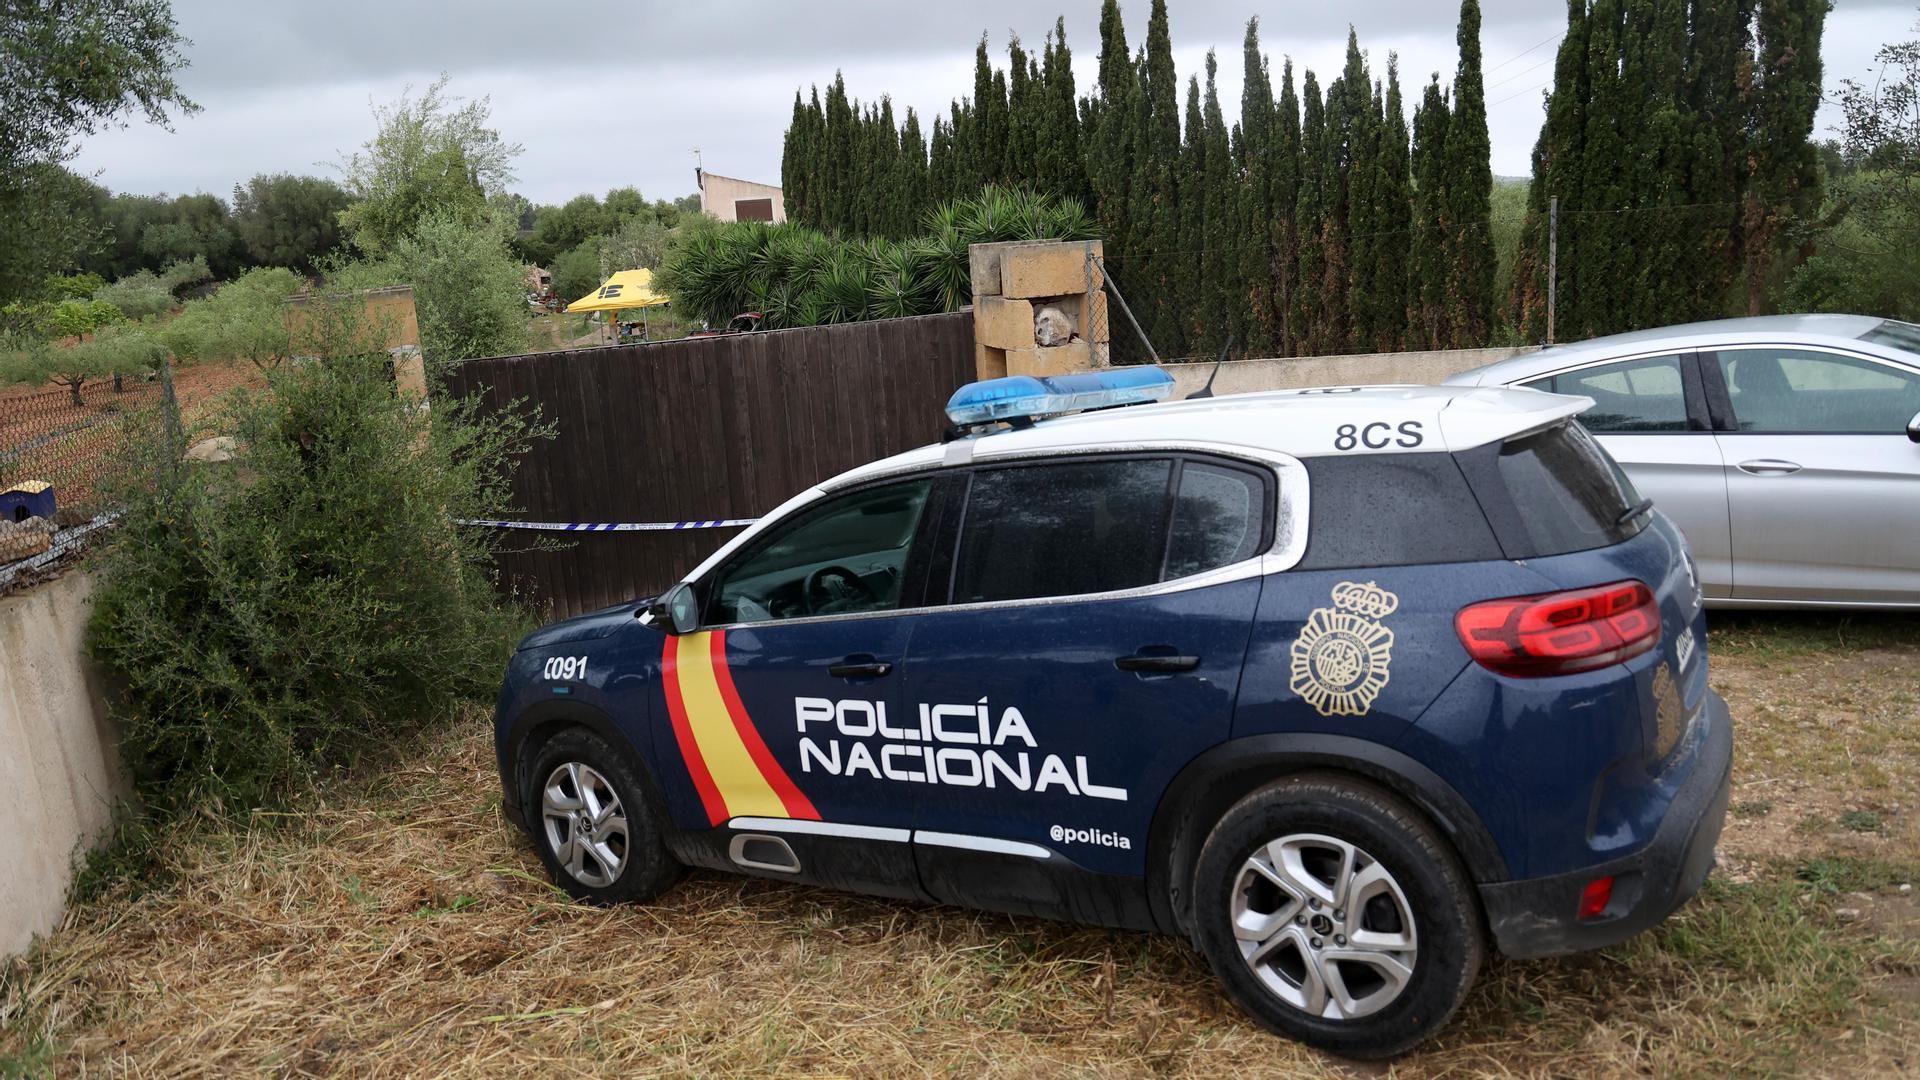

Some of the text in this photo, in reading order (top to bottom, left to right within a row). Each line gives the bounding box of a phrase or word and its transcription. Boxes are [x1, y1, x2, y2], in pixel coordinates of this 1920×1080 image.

[1334, 421, 1424, 450] 8CS
[795, 696, 1038, 747] POLICÍA
[799, 737, 1128, 801] NACIONAL
[1050, 824, 1132, 850] @policia
